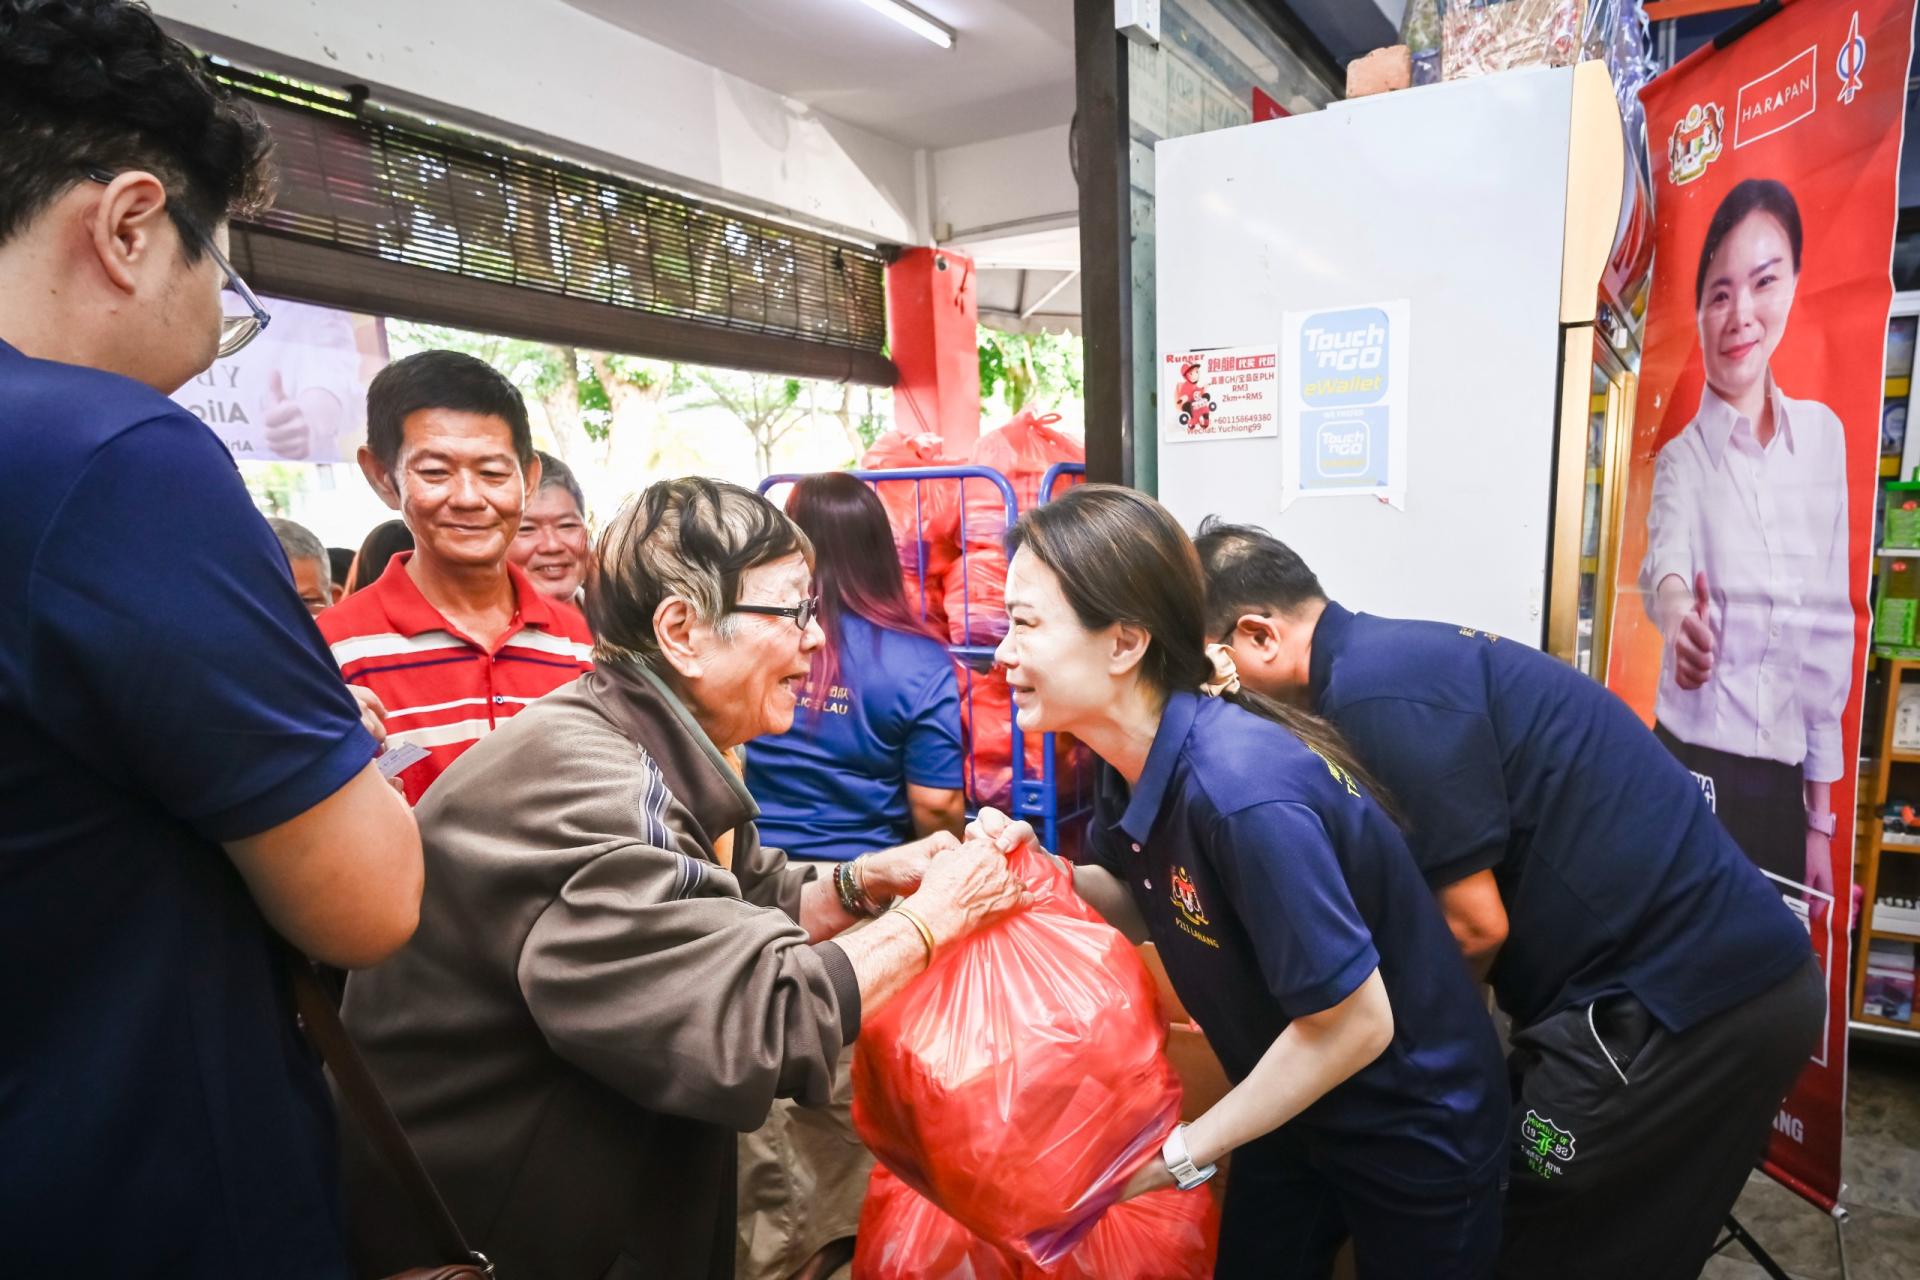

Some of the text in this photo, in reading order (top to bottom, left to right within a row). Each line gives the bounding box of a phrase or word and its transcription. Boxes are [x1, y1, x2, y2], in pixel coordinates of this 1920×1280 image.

[1742, 75, 1809, 123] HARAPAN
[1304, 323, 1385, 352] Touch
[1303, 374, 1382, 397] eWallet
[1321, 430, 1365, 445] Touch
[823, 702, 848, 715] LAU
